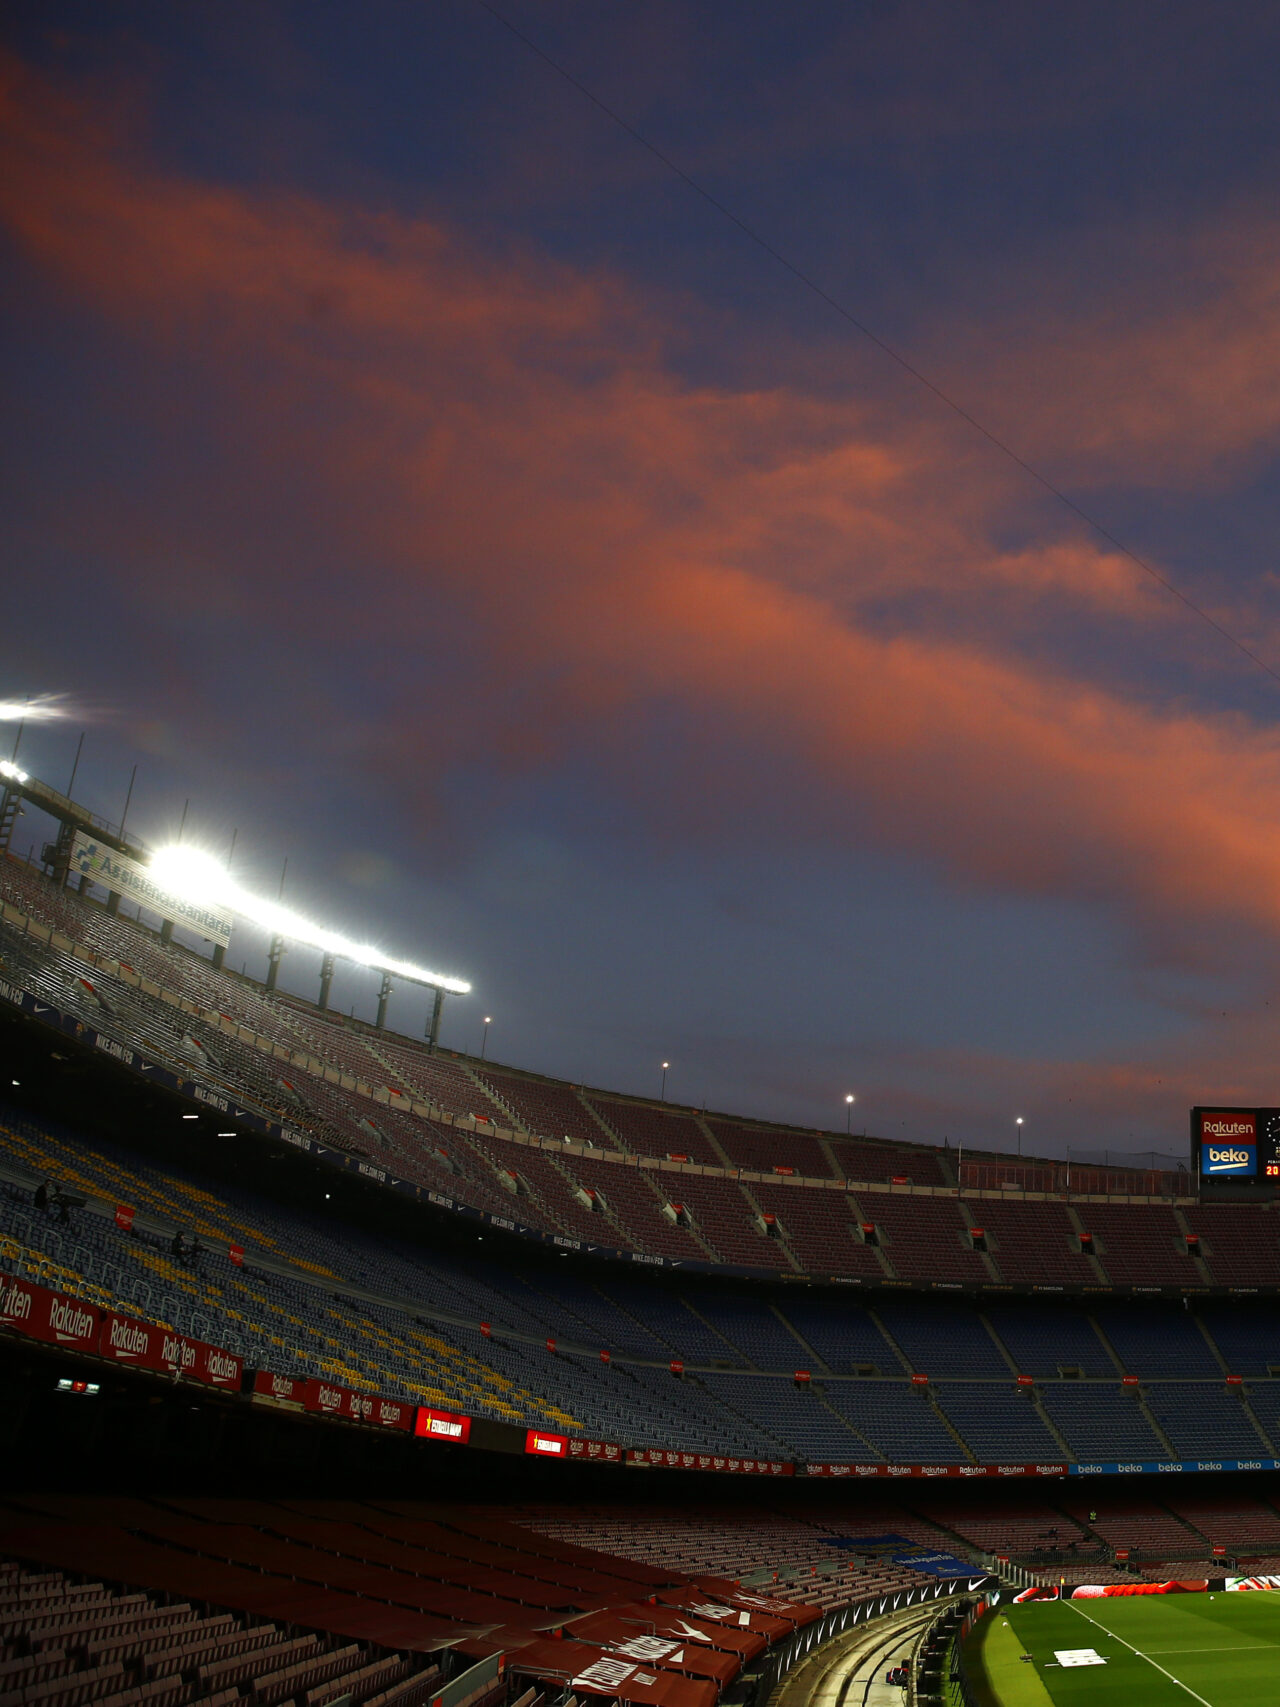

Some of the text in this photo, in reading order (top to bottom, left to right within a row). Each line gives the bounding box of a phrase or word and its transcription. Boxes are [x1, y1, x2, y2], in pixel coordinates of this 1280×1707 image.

[1203, 1121, 1253, 1133] Rakuten
[1209, 1148, 1249, 1162] beko
[1266, 1165, 1279, 1175] 20
[49, 1298, 93, 1338] Rakuten
[110, 1319, 148, 1354] Rakuten
[161, 1336, 195, 1367] Rakten
[272, 1374, 293, 1395] Rakuten
[318, 1385, 342, 1408] Rakuten
[379, 1402, 400, 1421] Rakuten
[856, 1465, 877, 1473] Rakuten
[888, 1465, 911, 1474] Rakuten
[922, 1466, 947, 1474] Rakuten
[959, 1466, 986, 1474] Rakuten
[1036, 1465, 1063, 1473] Rakuten
[1078, 1464, 1102, 1473] beko
[1118, 1463, 1142, 1473] beko
[1158, 1463, 1182, 1472] beko
[1198, 1461, 1222, 1471] beko
[1237, 1461, 1261, 1470] beko
